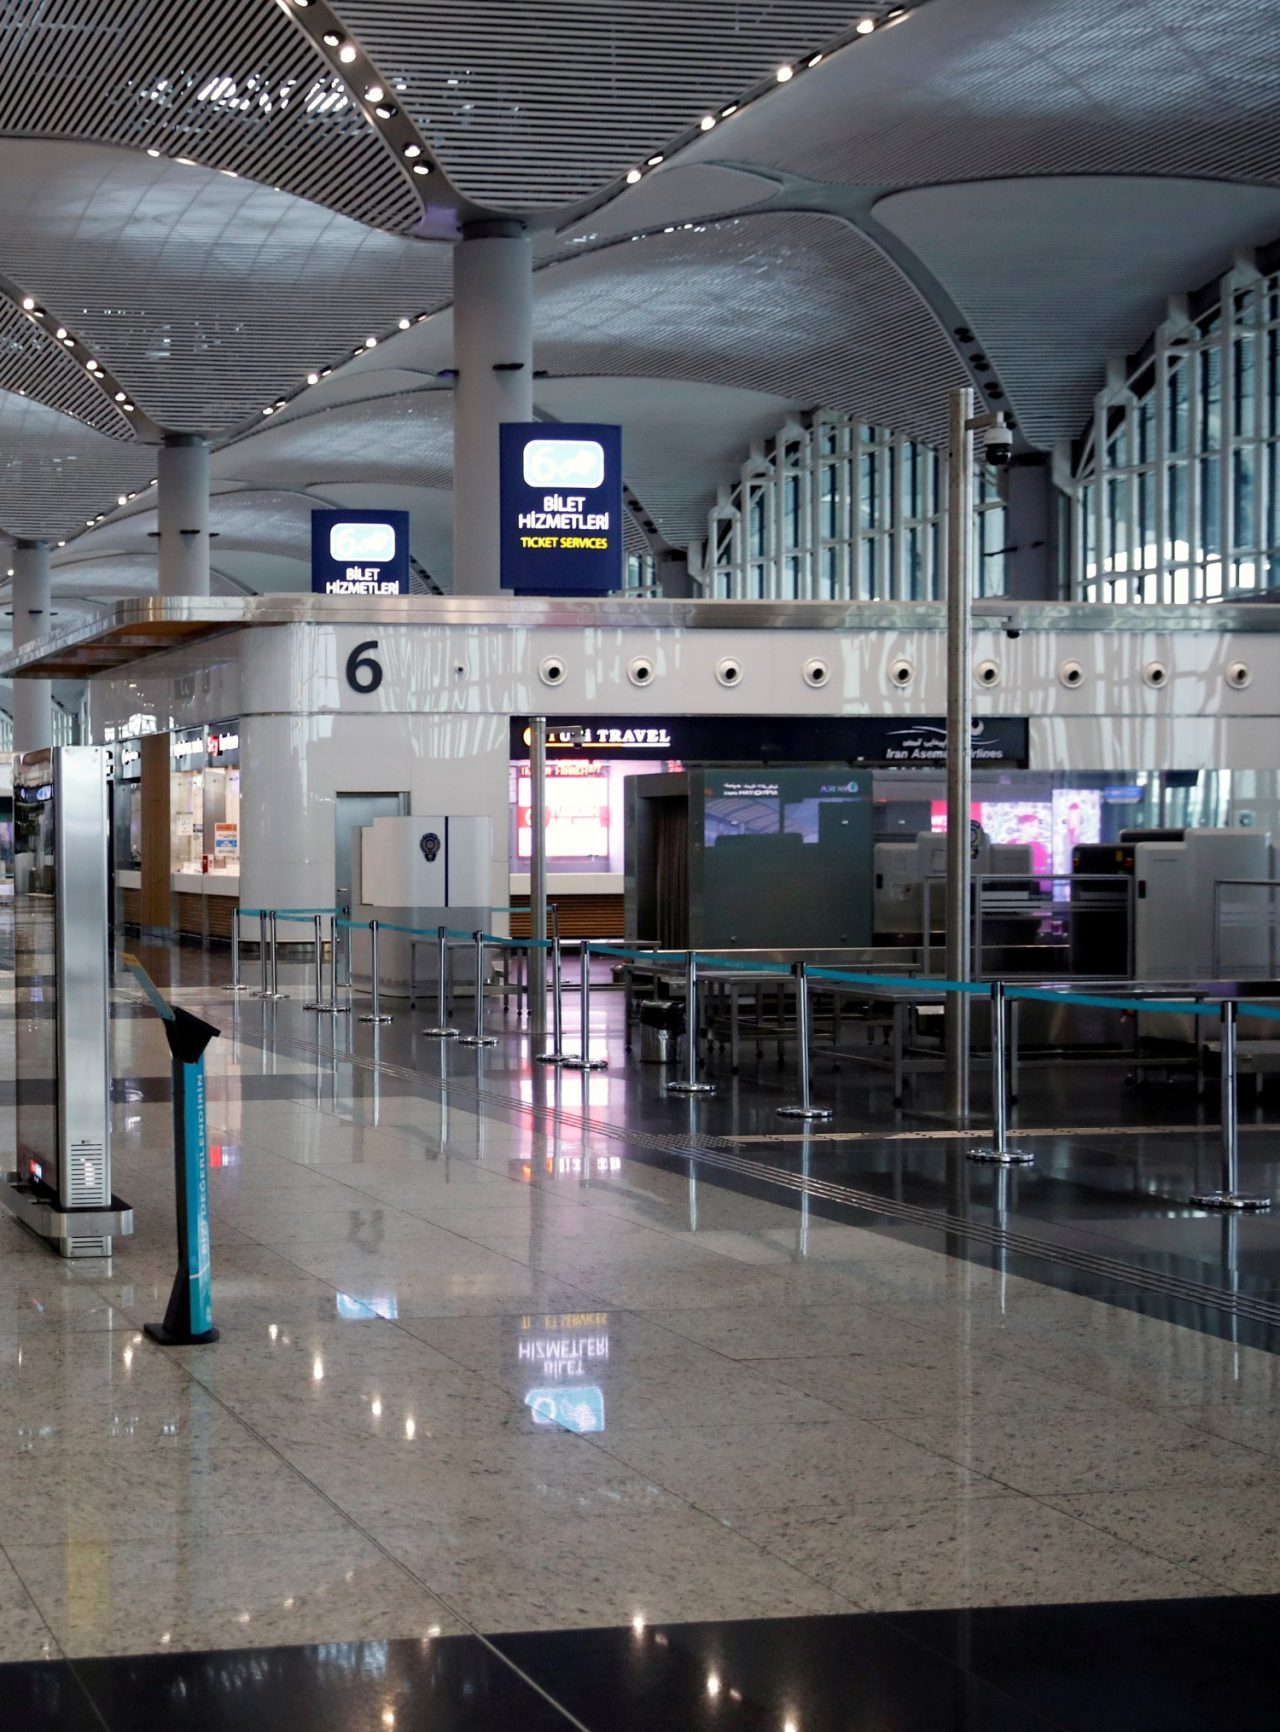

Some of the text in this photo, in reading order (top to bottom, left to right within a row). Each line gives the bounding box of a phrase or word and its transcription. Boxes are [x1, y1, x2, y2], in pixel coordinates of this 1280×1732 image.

[543, 494, 585, 512] BİLET
[518, 512, 610, 531] HİZMETLERİ
[520, 536, 608, 549] TICKET SERVICES
[345, 566, 380, 581] BİLET
[326, 580, 400, 595] HİZMETLERİ
[345, 640, 383, 693] 6
[597, 729, 670, 743] TRAVEL
[886, 748, 908, 759] Iran
